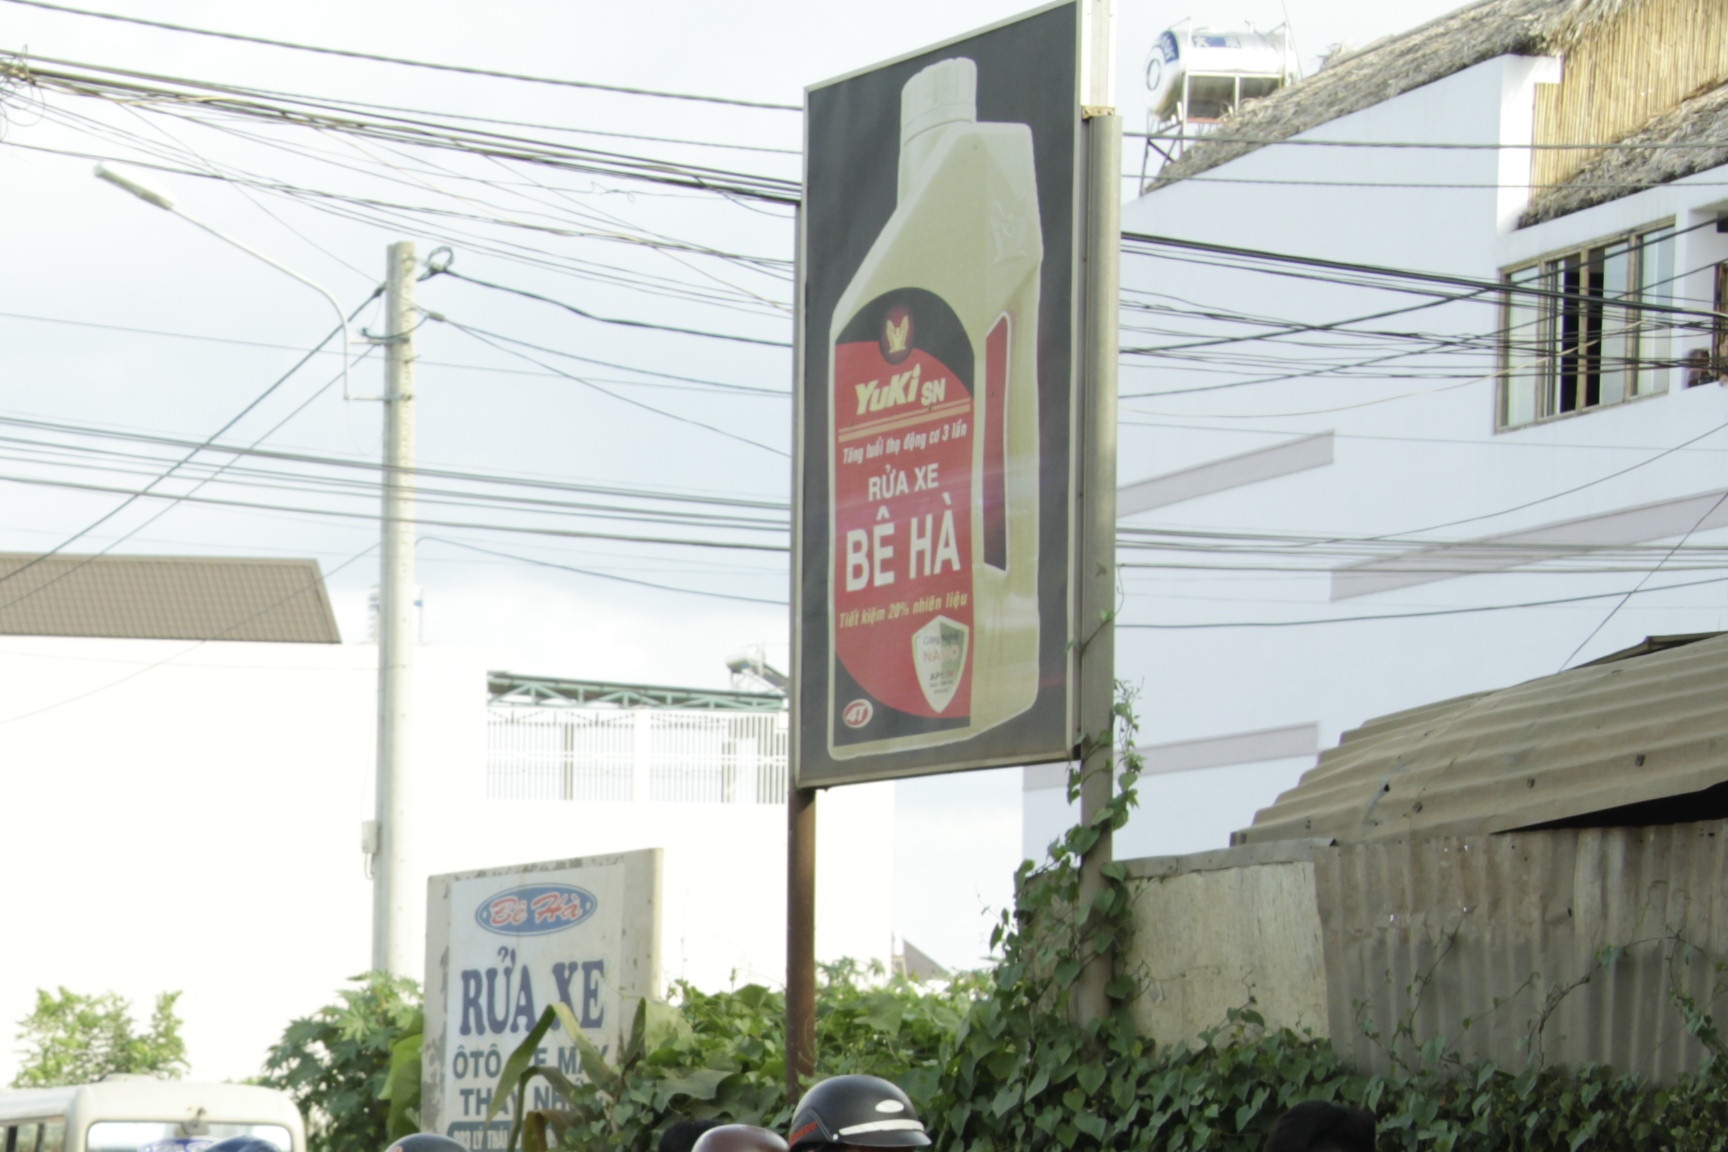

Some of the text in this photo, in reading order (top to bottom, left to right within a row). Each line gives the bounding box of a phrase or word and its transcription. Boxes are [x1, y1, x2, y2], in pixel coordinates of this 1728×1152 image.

[855, 363, 946, 415] YuKi SN
[942, 424, 949, 441] 3
[868, 463, 939, 501] RỬA XE
[909, 492, 961, 580] HÀ
[888, 602, 909, 619] 20%
[531, 892, 582, 924] Hà
[460, 946, 604, 1036] RỬA XE
[453, 1043, 501, 1079] ÔTÔ
